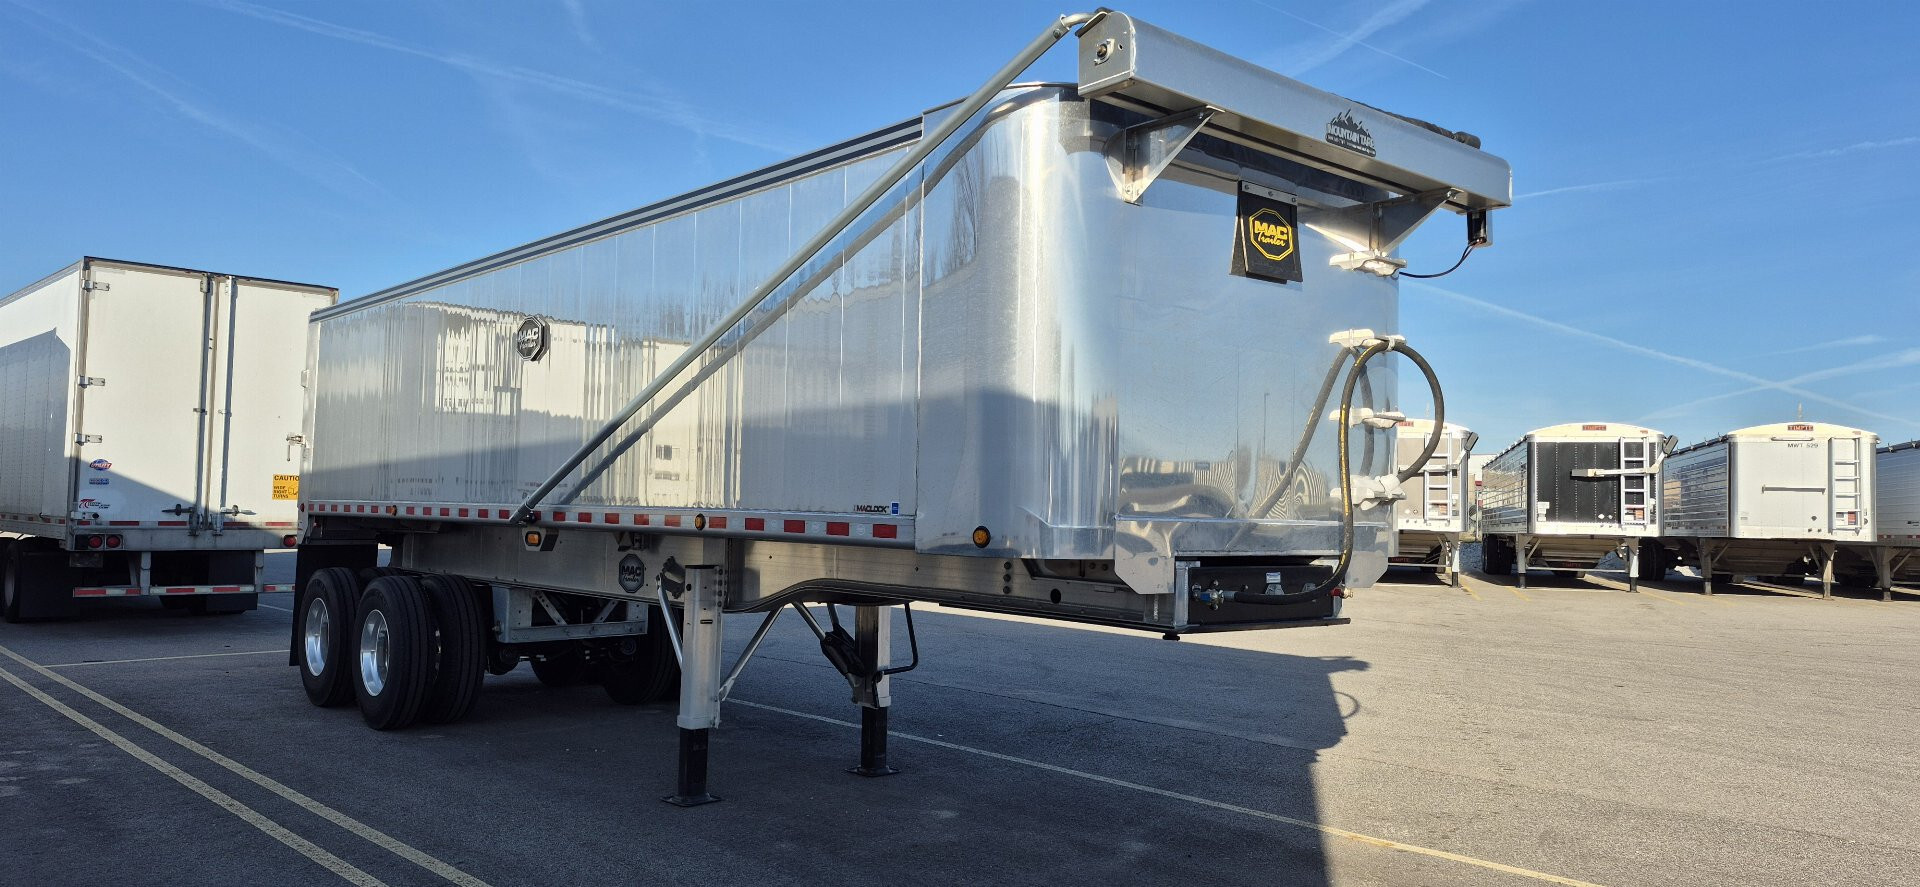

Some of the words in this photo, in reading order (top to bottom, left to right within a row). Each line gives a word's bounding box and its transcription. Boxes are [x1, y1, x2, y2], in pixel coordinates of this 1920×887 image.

[1327, 123, 1361, 145] MOUNTAIN
[1254, 220, 1288, 240] MAC
[1257, 231, 1286, 247] Trailer
[518, 327, 539, 341] MAC
[856, 504, 887, 513] MACLOCK
[621, 565, 642, 577] MAC
